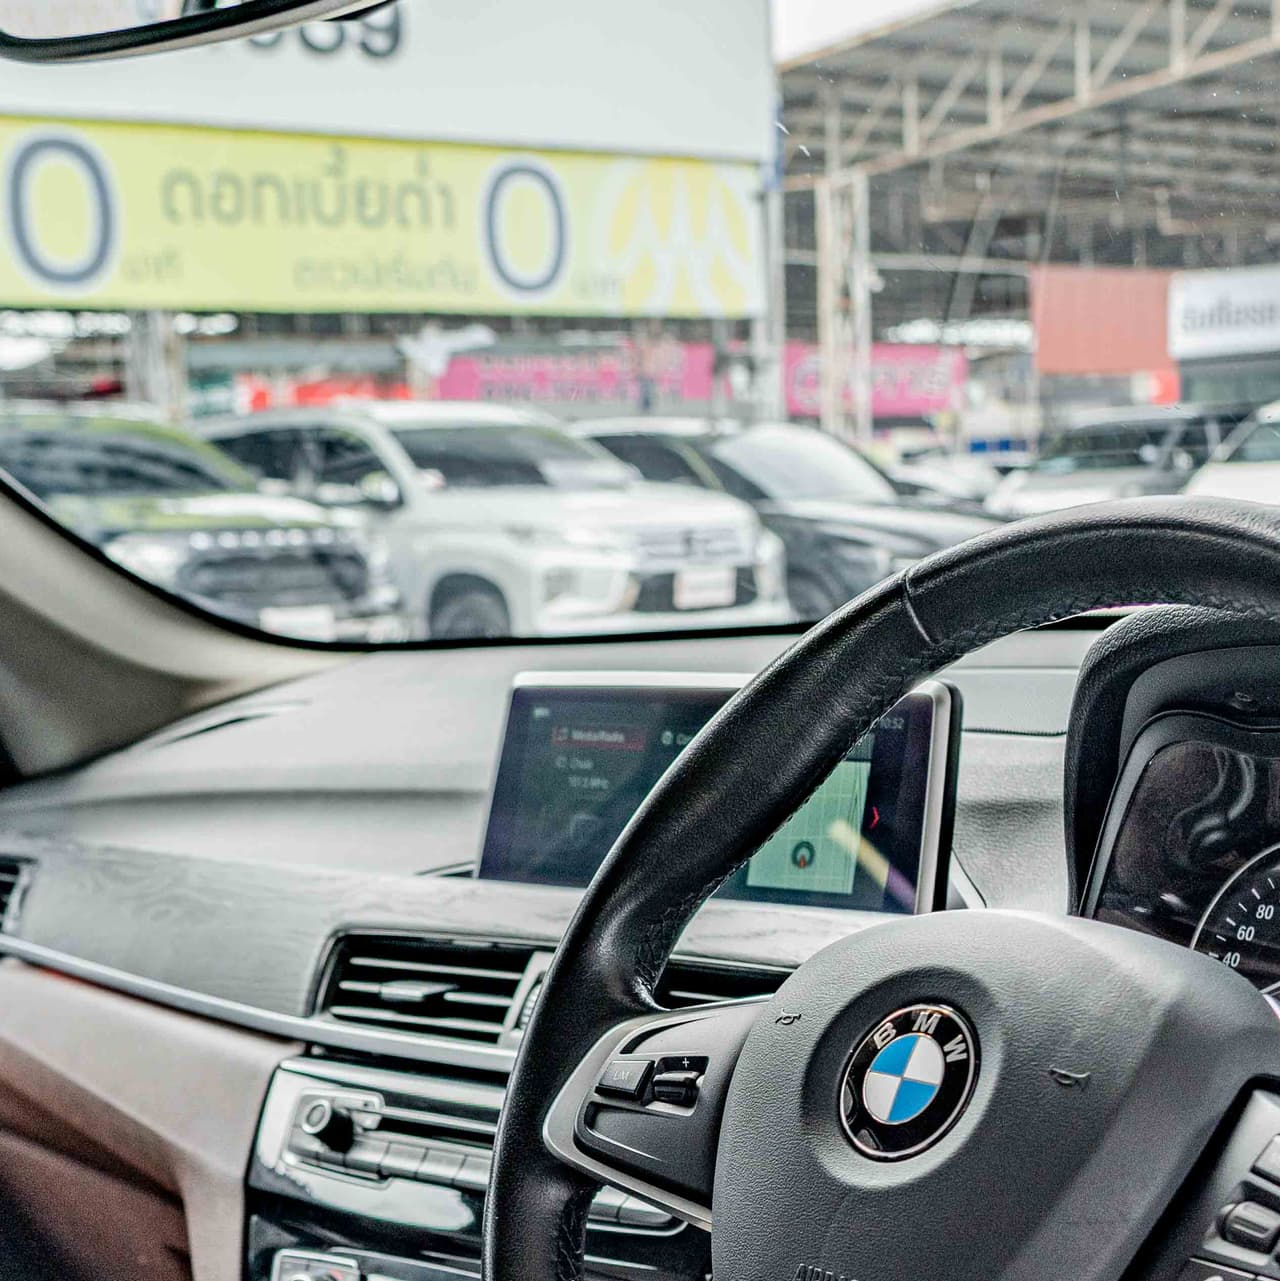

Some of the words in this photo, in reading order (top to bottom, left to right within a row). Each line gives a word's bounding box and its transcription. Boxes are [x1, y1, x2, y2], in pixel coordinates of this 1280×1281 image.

[1255, 904, 1274, 920] 80
[1236, 926, 1255, 942] 60
[1223, 952, 1241, 968] 40
[873, 1011, 968, 1063] BMW
